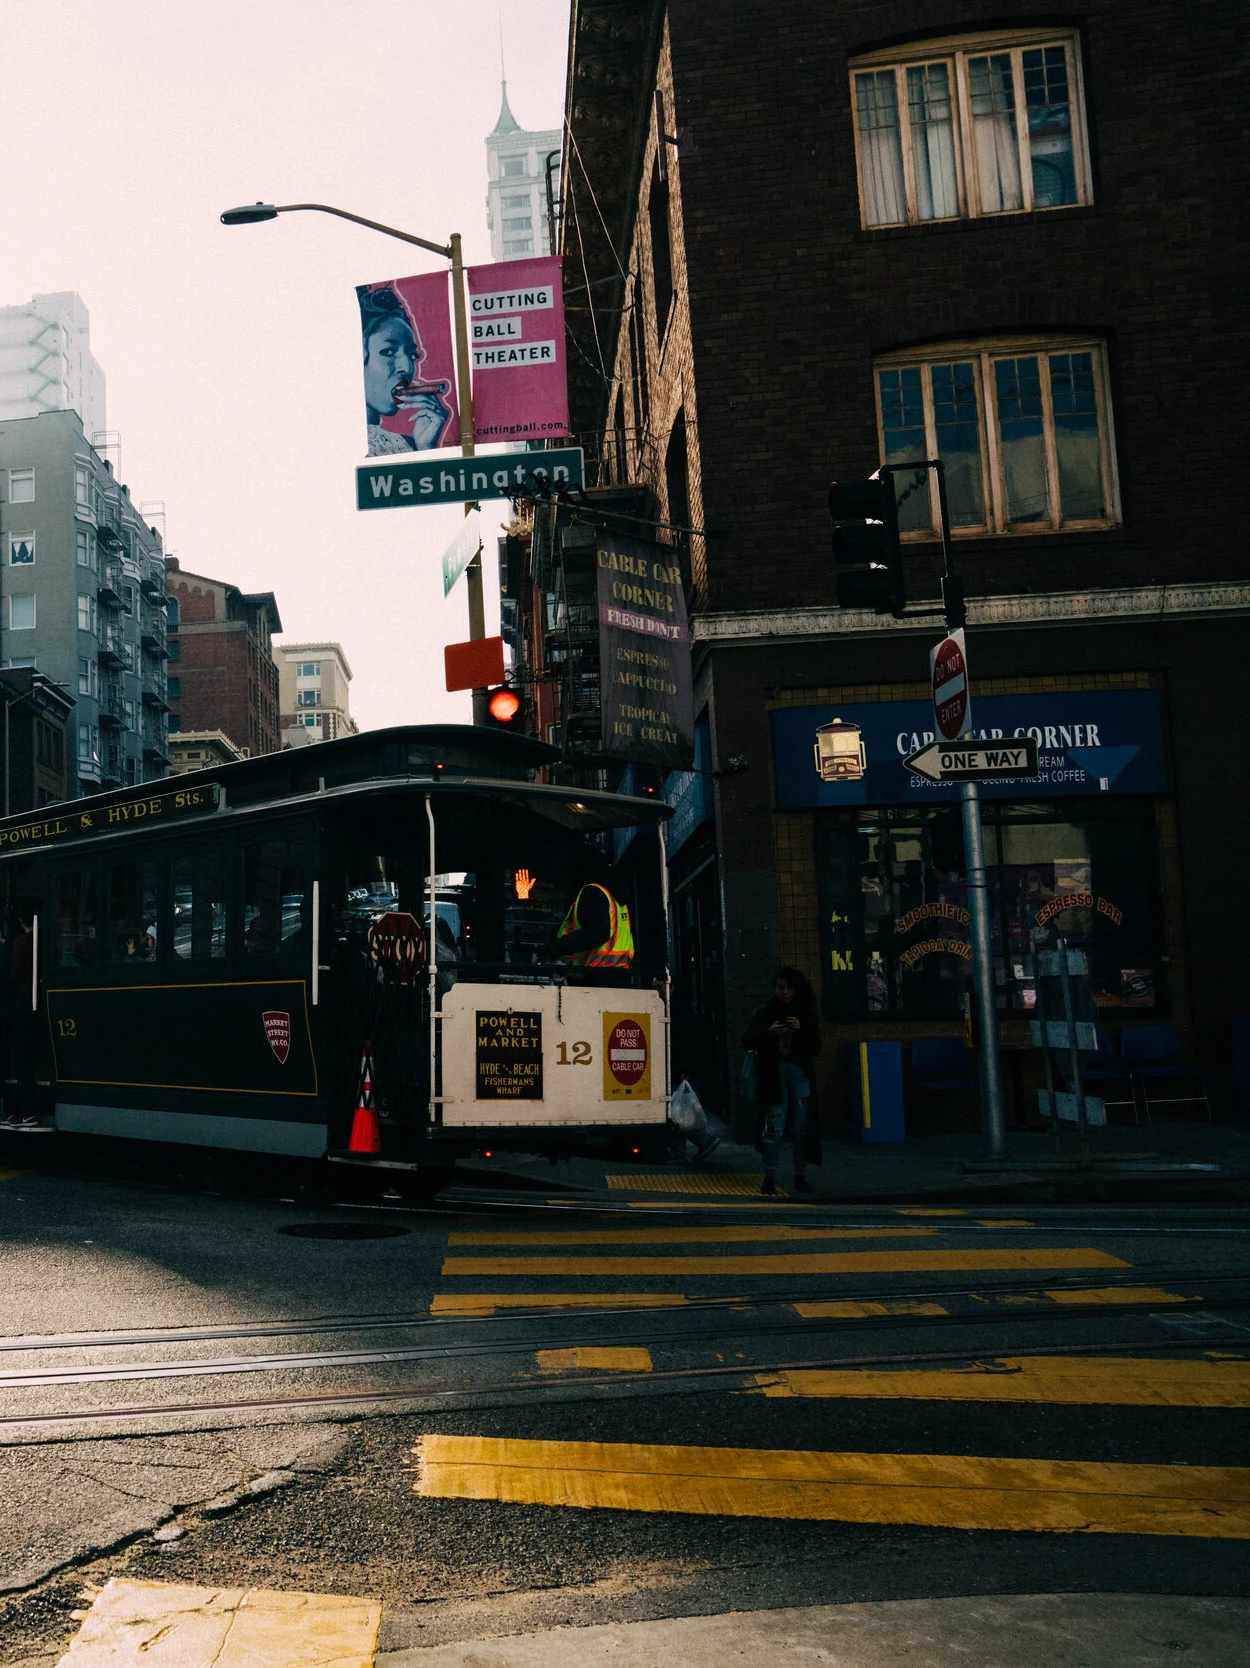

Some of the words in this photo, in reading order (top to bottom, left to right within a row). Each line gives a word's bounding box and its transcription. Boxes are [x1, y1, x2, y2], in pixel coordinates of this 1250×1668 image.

[472, 292, 548, 311] CUTTING
[473, 323, 517, 338] BALL
[473, 346, 551, 365] THEATER
[476, 421, 564, 436] cuttingball.com
[369, 463, 570, 498] Washington
[597, 549, 648, 578] CABLE
[653, 562, 682, 585] CAR
[612, 580, 675, 613] CORNER
[607, 608, 645, 630] FRESH
[616, 647, 670, 670] ESPRESSO
[935, 664, 945, 681] DO
[947, 653, 960, 673] NOT
[941, 700, 961, 724] ENTER
[613, 721, 633, 737] ICE
[941, 752, 979, 769] ONE
[984, 750, 1022, 767] WAY
[1039, 756, 1065, 768] REAM
[1051, 769, 1086, 783] COFFEE
[79, 813, 94, 829] &
[108, 799, 162, 822] HYDE
[174, 792, 204, 809] Sts.
[1035, 893, 1094, 927] ESPRESSO
[1097, 895, 1123, 927] BAR
[897, 902, 954, 935] SMOOTHIE
[957, 907, 971, 927] IC
[58, 1018, 77, 1038] 12
[264, 1019, 289, 1028] MARKET
[479, 1017, 538, 1029] POWELL
[267, 1029, 289, 1037] STREET
[495, 1028, 524, 1037] AND
[615, 1029, 626, 1038] DO
[627, 1029, 641, 1038] NOT
[478, 1037, 539, 1048] MARKET
[620, 1038, 637, 1047] PASS
[556, 1040, 593, 1066] 12
[479, 1062, 501, 1075] HYDE
[513, 1063, 540, 1076] BEACH
[612, 1062, 631, 1071] CABLE
[632, 1062, 644, 1071] CAR
[484, 1077, 535, 1086] FISHERMANS
[496, 1086, 523, 1095] WHARF
